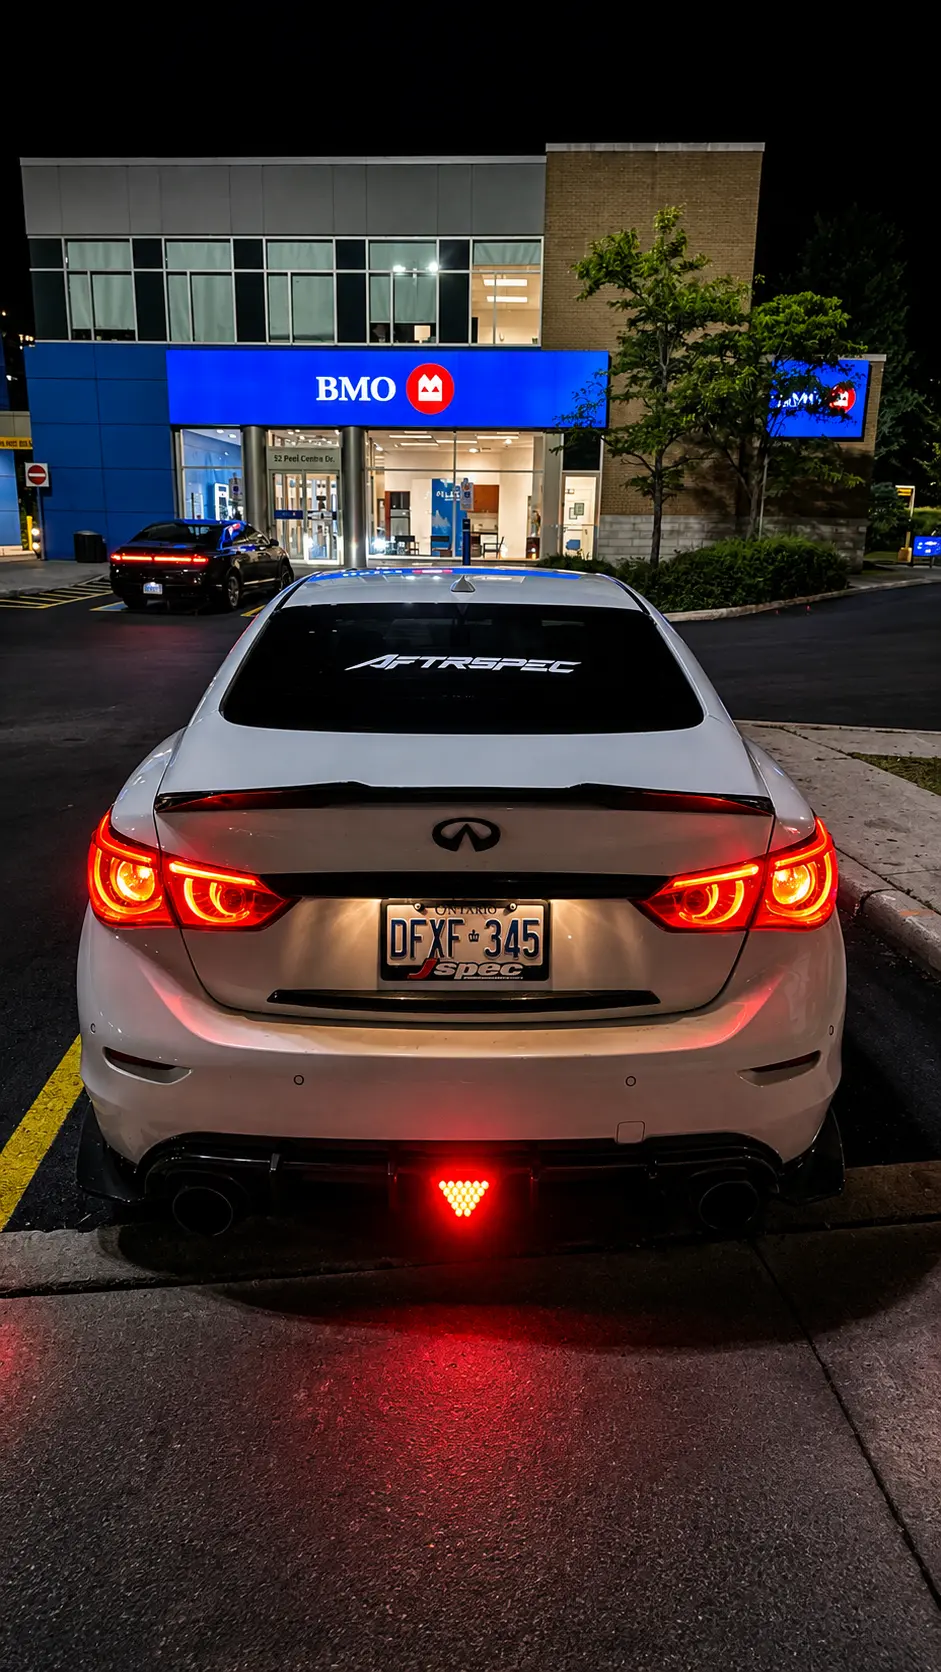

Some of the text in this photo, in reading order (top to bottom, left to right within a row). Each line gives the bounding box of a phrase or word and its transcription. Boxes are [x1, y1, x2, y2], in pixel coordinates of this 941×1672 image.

[316, 376, 396, 401] BMO
[274, 454, 282, 462] 52
[284, 454, 299, 462] Peel
[325, 455, 335, 463] Dr.
[344, 653, 582, 673] AFTRSPEC
[435, 905, 497, 915] ONTARIO
[390, 918, 541, 959] DFXF 345
